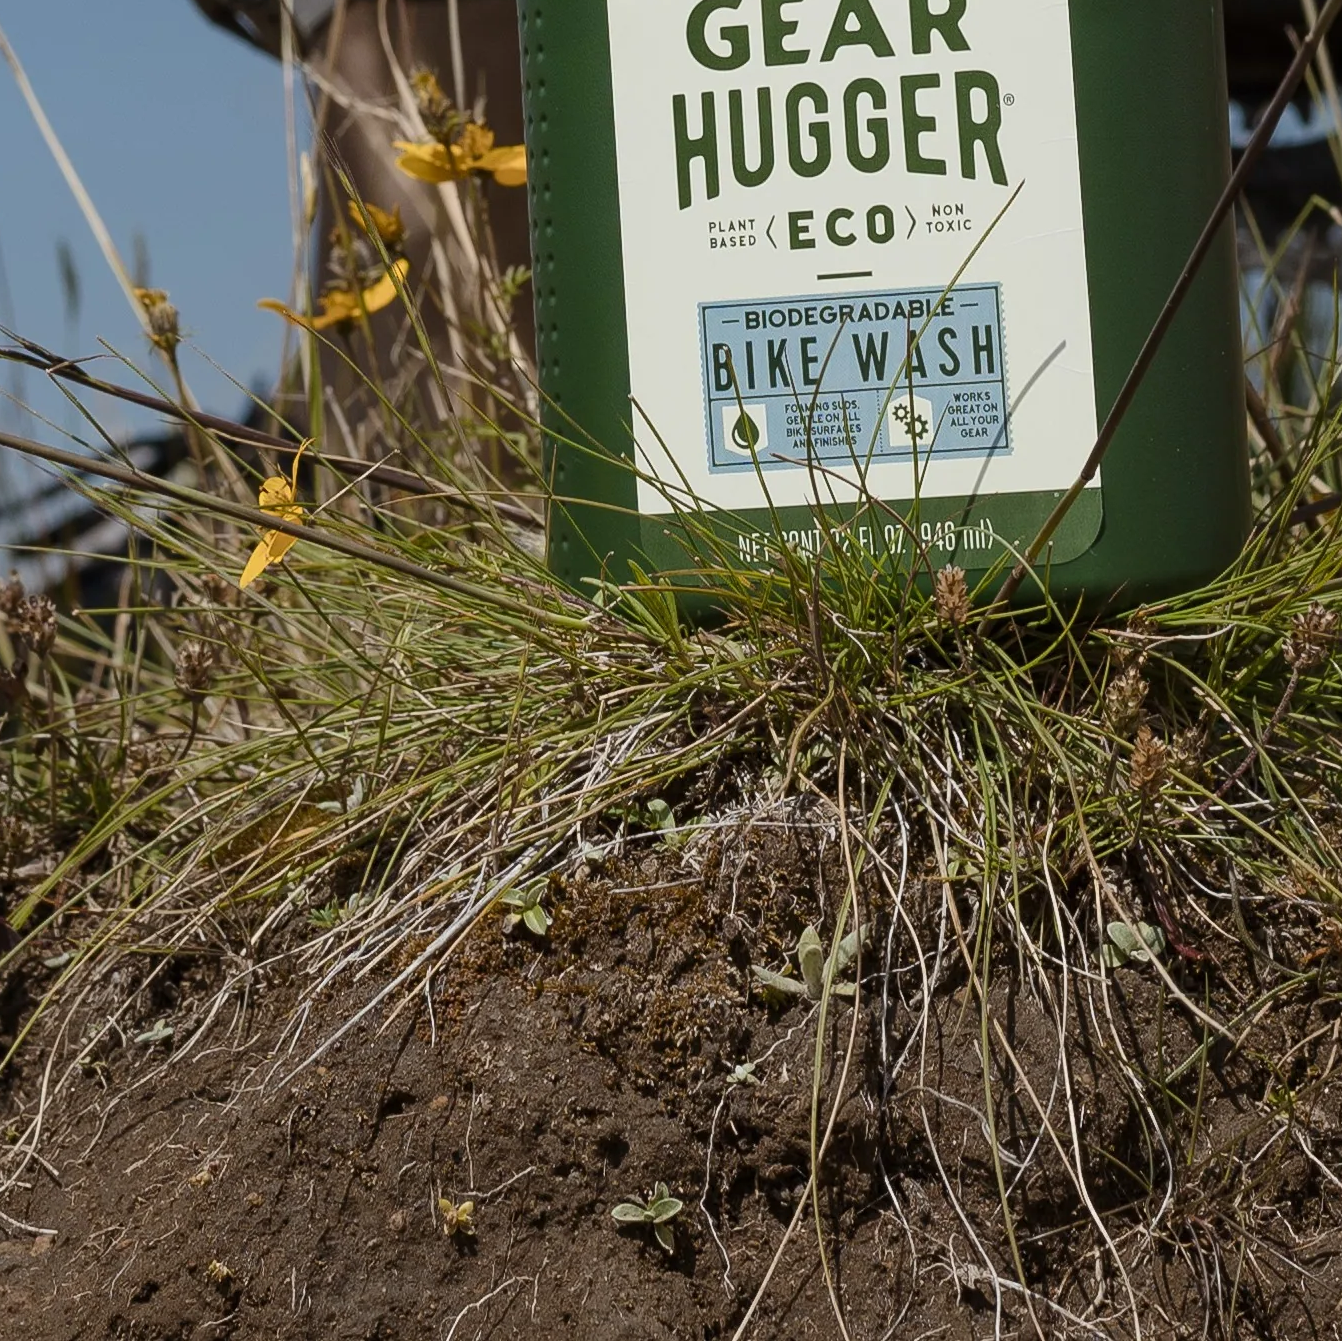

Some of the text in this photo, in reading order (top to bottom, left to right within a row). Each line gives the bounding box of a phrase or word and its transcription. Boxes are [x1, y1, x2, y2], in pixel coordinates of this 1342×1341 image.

[932, 203, 964, 217] NON
[708, 219, 756, 233] PLANT
[788, 204, 895, 251] ECO
[926, 219, 972, 234] TOXIC
[710, 235, 757, 249] BASED
[745, 297, 955, 330] BIODEGRADABLE
[712, 325, 995, 392] BIKE WASH
[953, 391, 991, 402] WORKS
[947, 402, 998, 415] GREAT ON
[825, 413, 839, 422] ON
[842, 411, 860, 422] LL
[950, 415, 999, 427] ALL YOUR
[960, 427, 989, 438] GEAR
[792, 438, 809, 449] AN
[738, 532, 771, 563] NET
